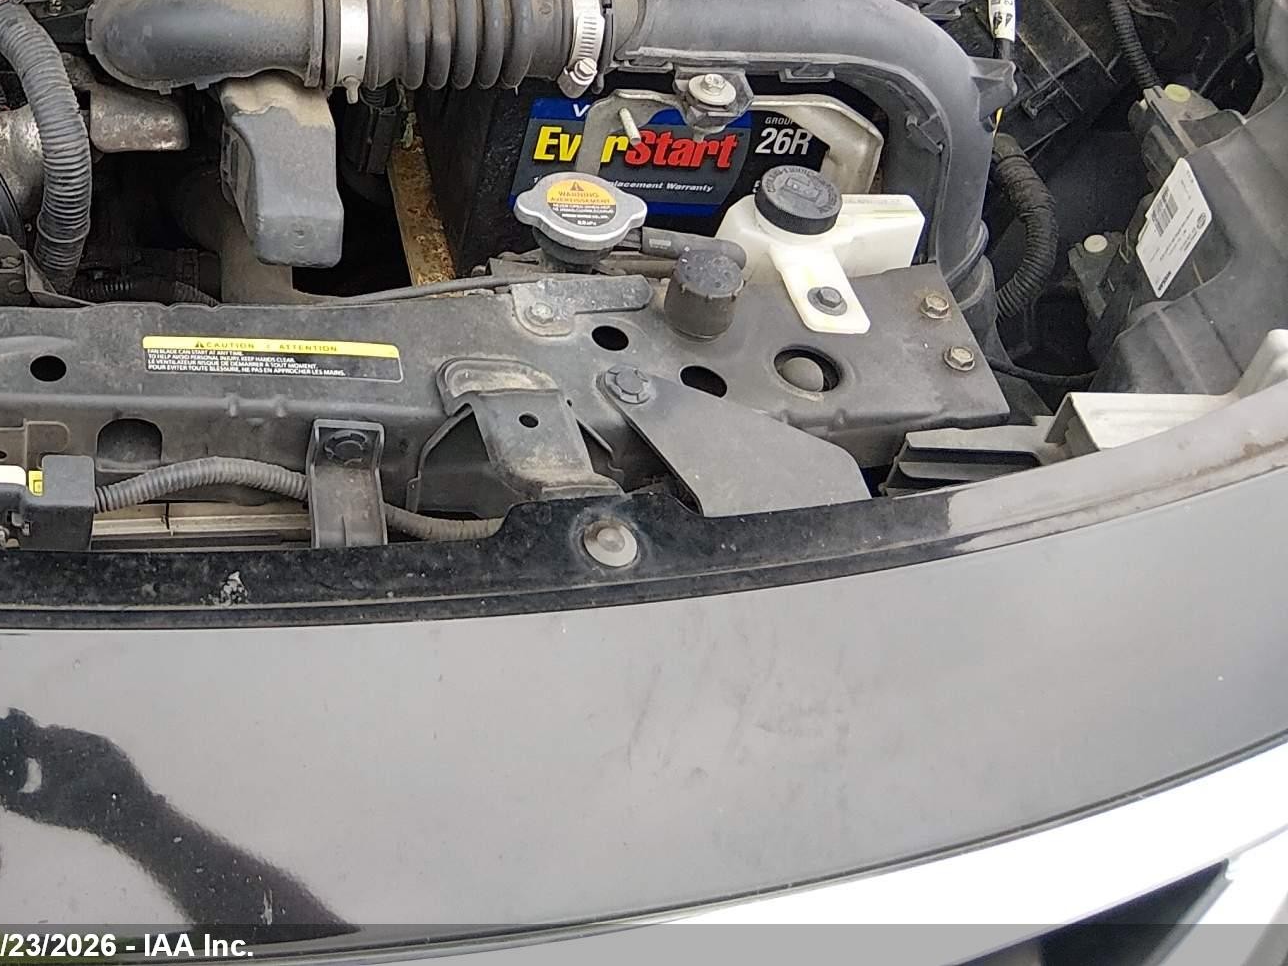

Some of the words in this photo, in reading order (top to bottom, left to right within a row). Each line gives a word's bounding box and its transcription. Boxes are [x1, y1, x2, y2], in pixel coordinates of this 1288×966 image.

[533, 125, 738, 169] EvrStart
[755, 127, 813, 156] 26R
[665, 181, 714, 194] Warranty
